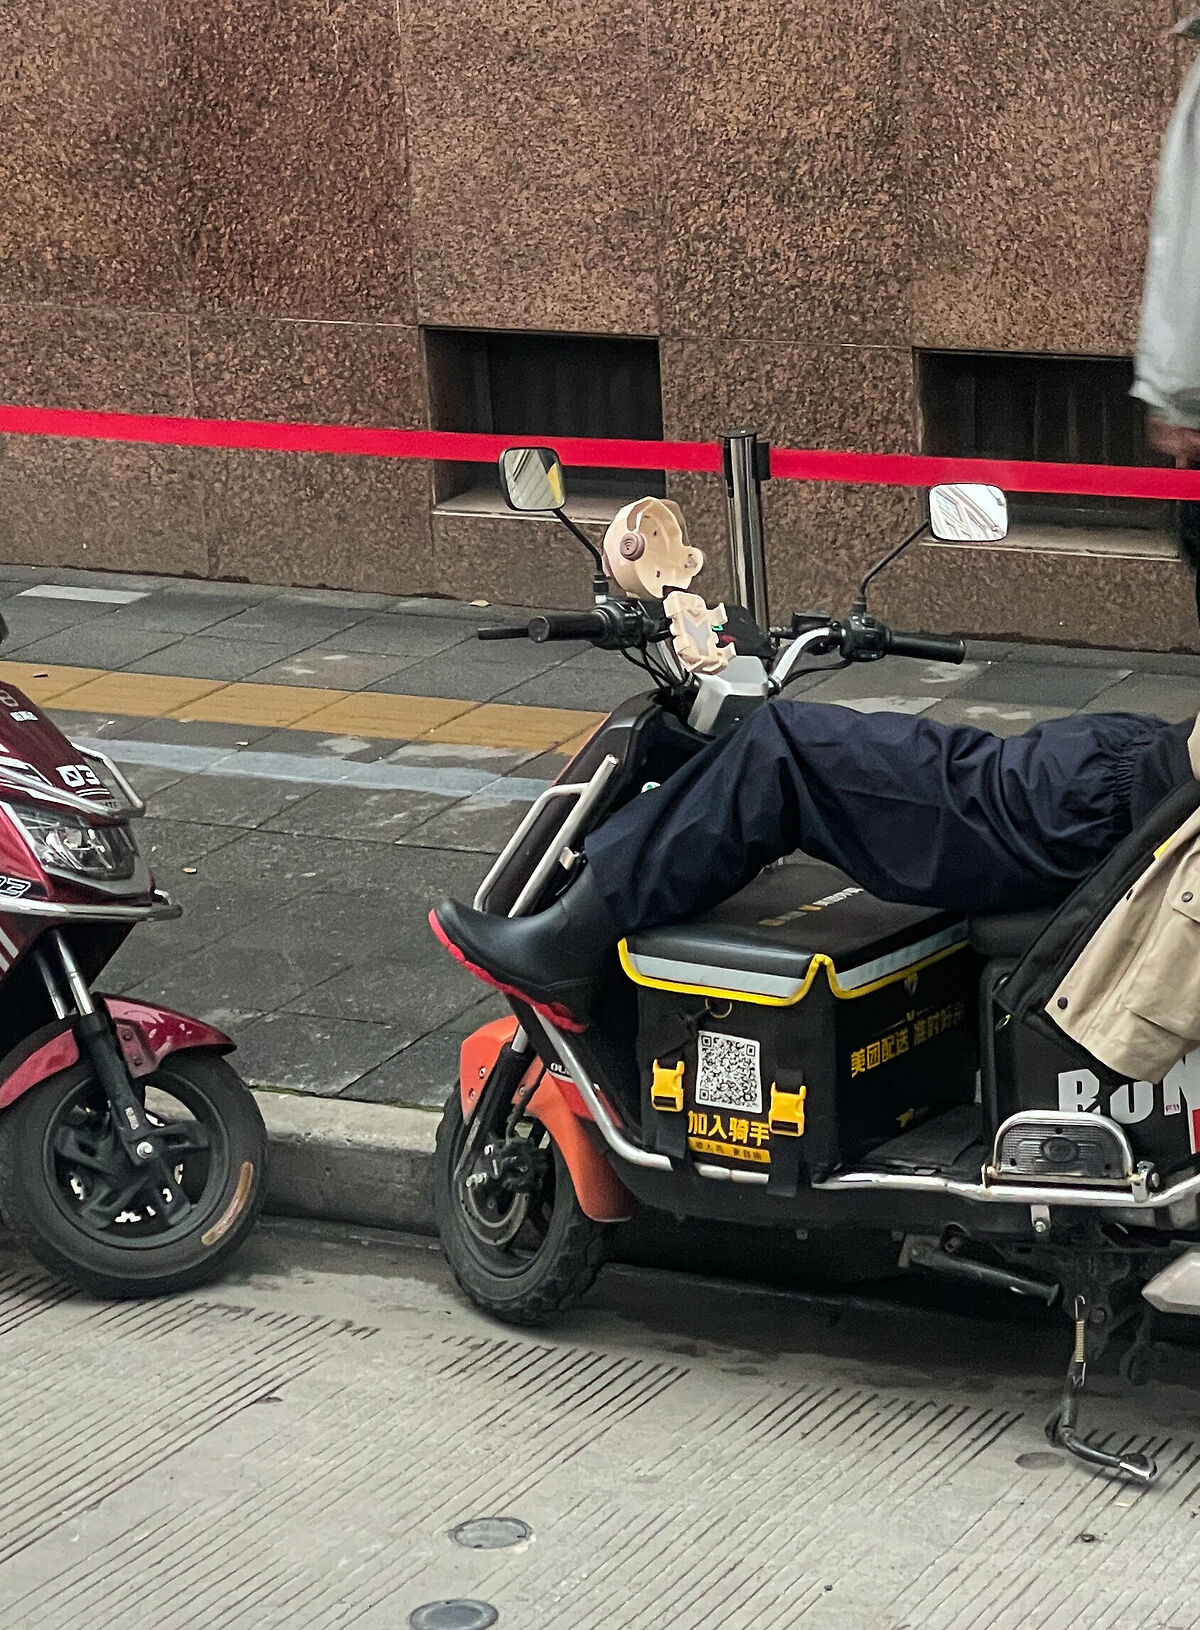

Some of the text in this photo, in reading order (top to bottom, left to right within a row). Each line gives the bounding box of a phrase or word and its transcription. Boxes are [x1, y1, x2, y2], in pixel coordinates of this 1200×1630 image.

[850, 1027, 910, 1078] 美团配送
[688, 1110, 769, 1146] 加入骑手
